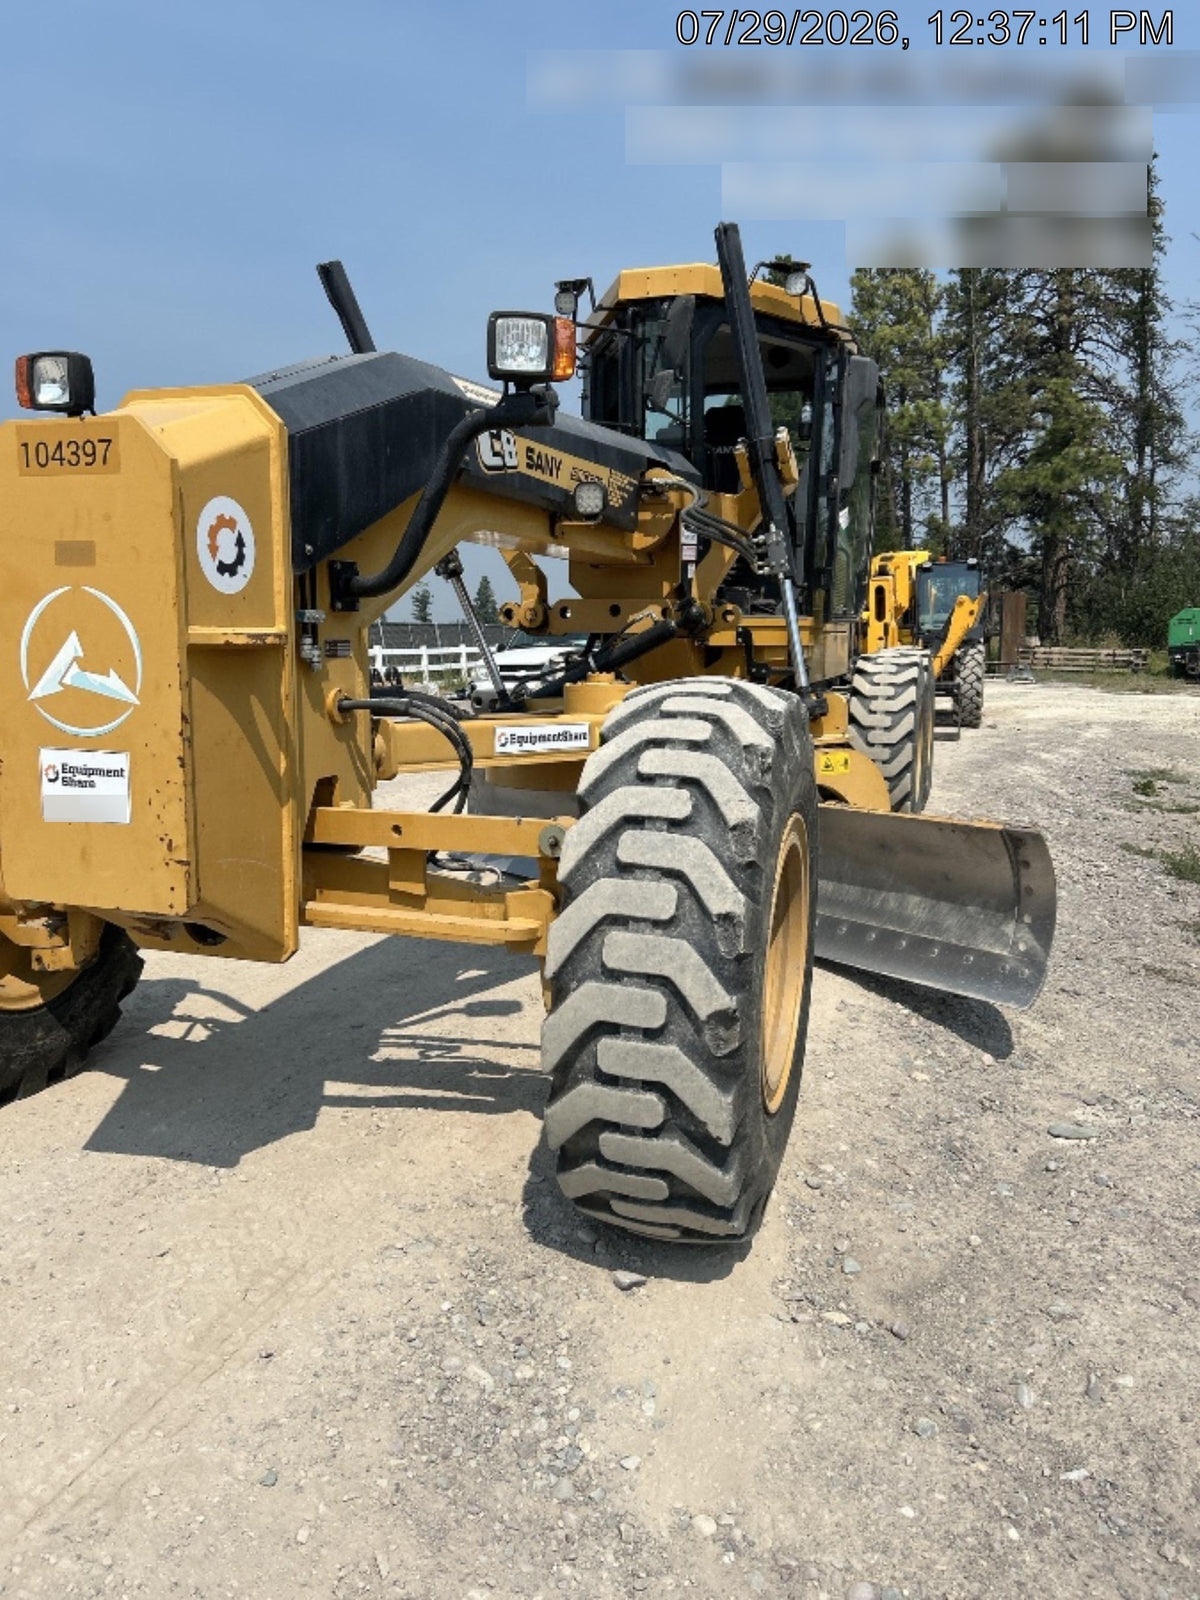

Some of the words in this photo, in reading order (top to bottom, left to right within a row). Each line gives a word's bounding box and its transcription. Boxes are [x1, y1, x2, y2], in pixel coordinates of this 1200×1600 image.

[20, 438, 113, 468] 104397
[525, 446, 563, 479] SANY
[509, 730, 588, 747] EquipmentShare
[61, 763, 126, 778] Equipment
[61, 776, 97, 788] Share
